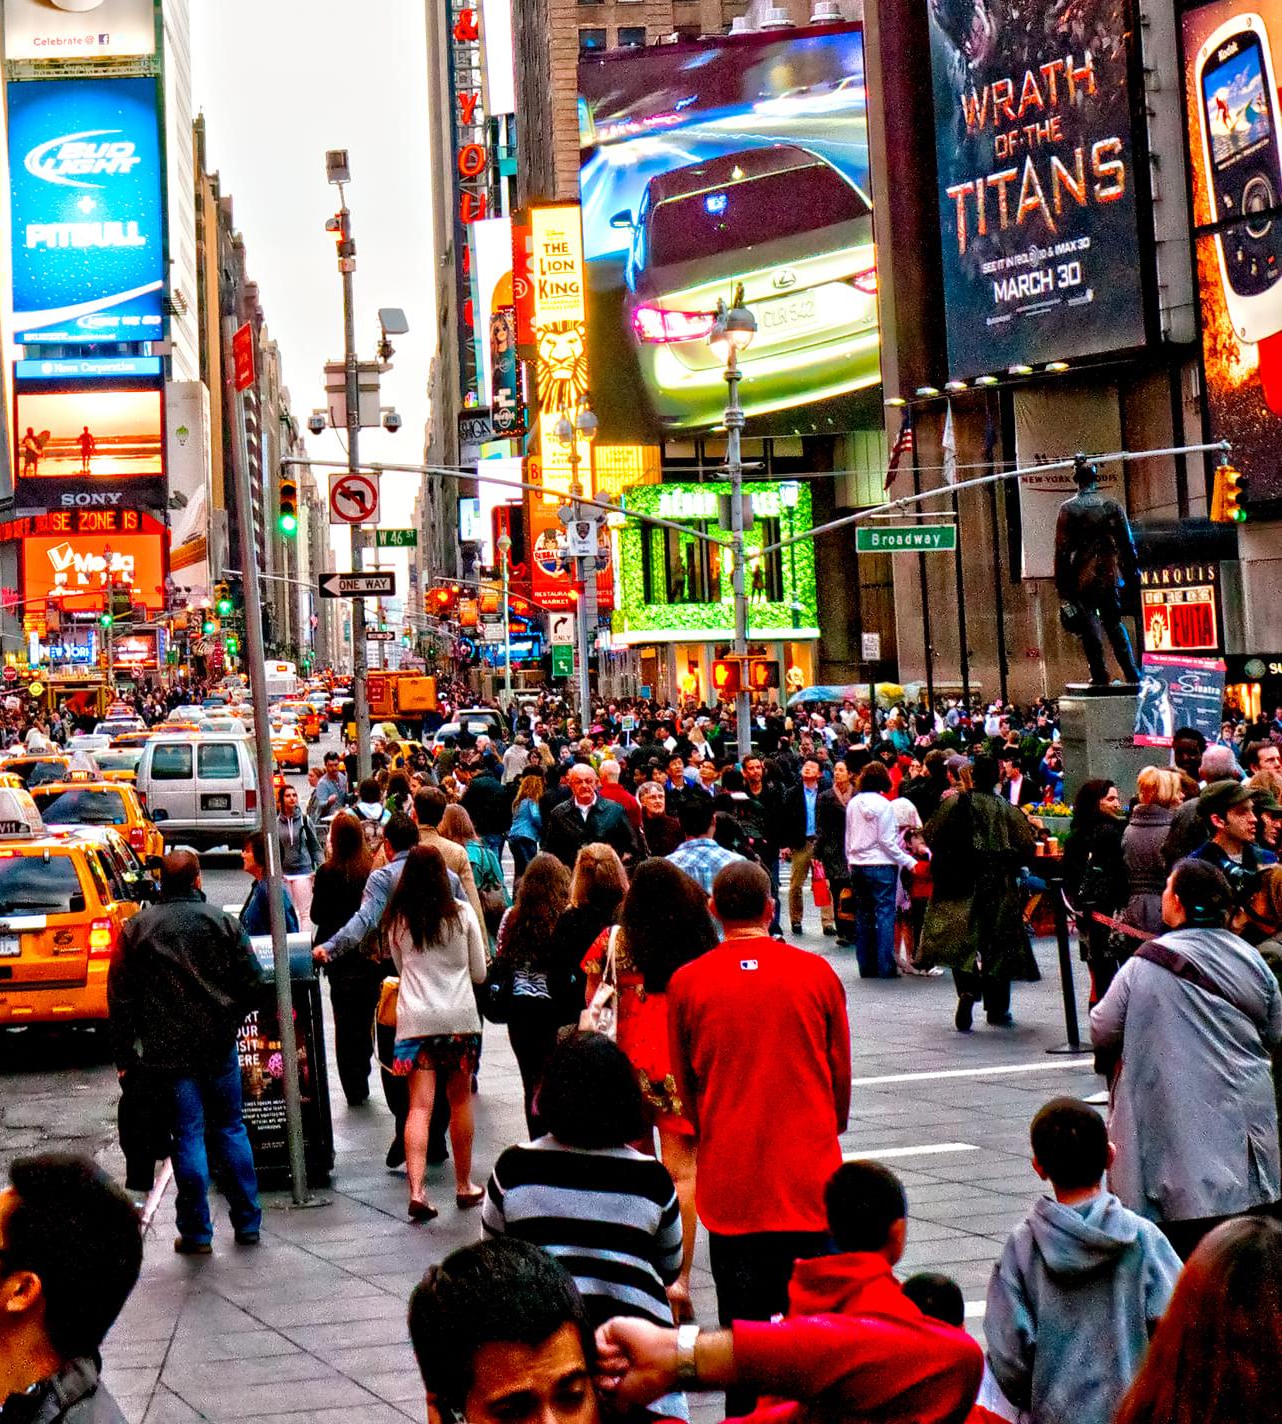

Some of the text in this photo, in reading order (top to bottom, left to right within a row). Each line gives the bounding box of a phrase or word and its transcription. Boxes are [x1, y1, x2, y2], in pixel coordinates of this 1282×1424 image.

[454, 8, 479, 42] &
[33, 35, 83, 47] Celebrate
[960, 50, 1098, 131] WRATH
[994, 114, 1064, 159] OF THE
[56, 141, 136, 159] BUD
[41, 156, 141, 175] LIGHT
[945, 135, 1127, 257] TITANS
[26, 220, 147, 249] PITBULL
[543, 241, 568, 253] THE
[982, 260, 998, 274] SEE
[997, 259, 1005, 271] IT
[1055, 242, 1076, 257] IMAX
[1075, 236, 1091, 250] 3D
[538, 280, 580, 300] KING
[993, 261, 1082, 303] MARCH 30
[60, 491, 123, 506] SONY
[79, 511, 117, 531] ZONE
[123, 511, 138, 529] IS
[378, 530, 416, 546] W 46 ST
[871, 531, 942, 547] Broadway
[338, 578, 388, 591] ONE WAY
[1140, 565, 1216, 586] MARQUIS
